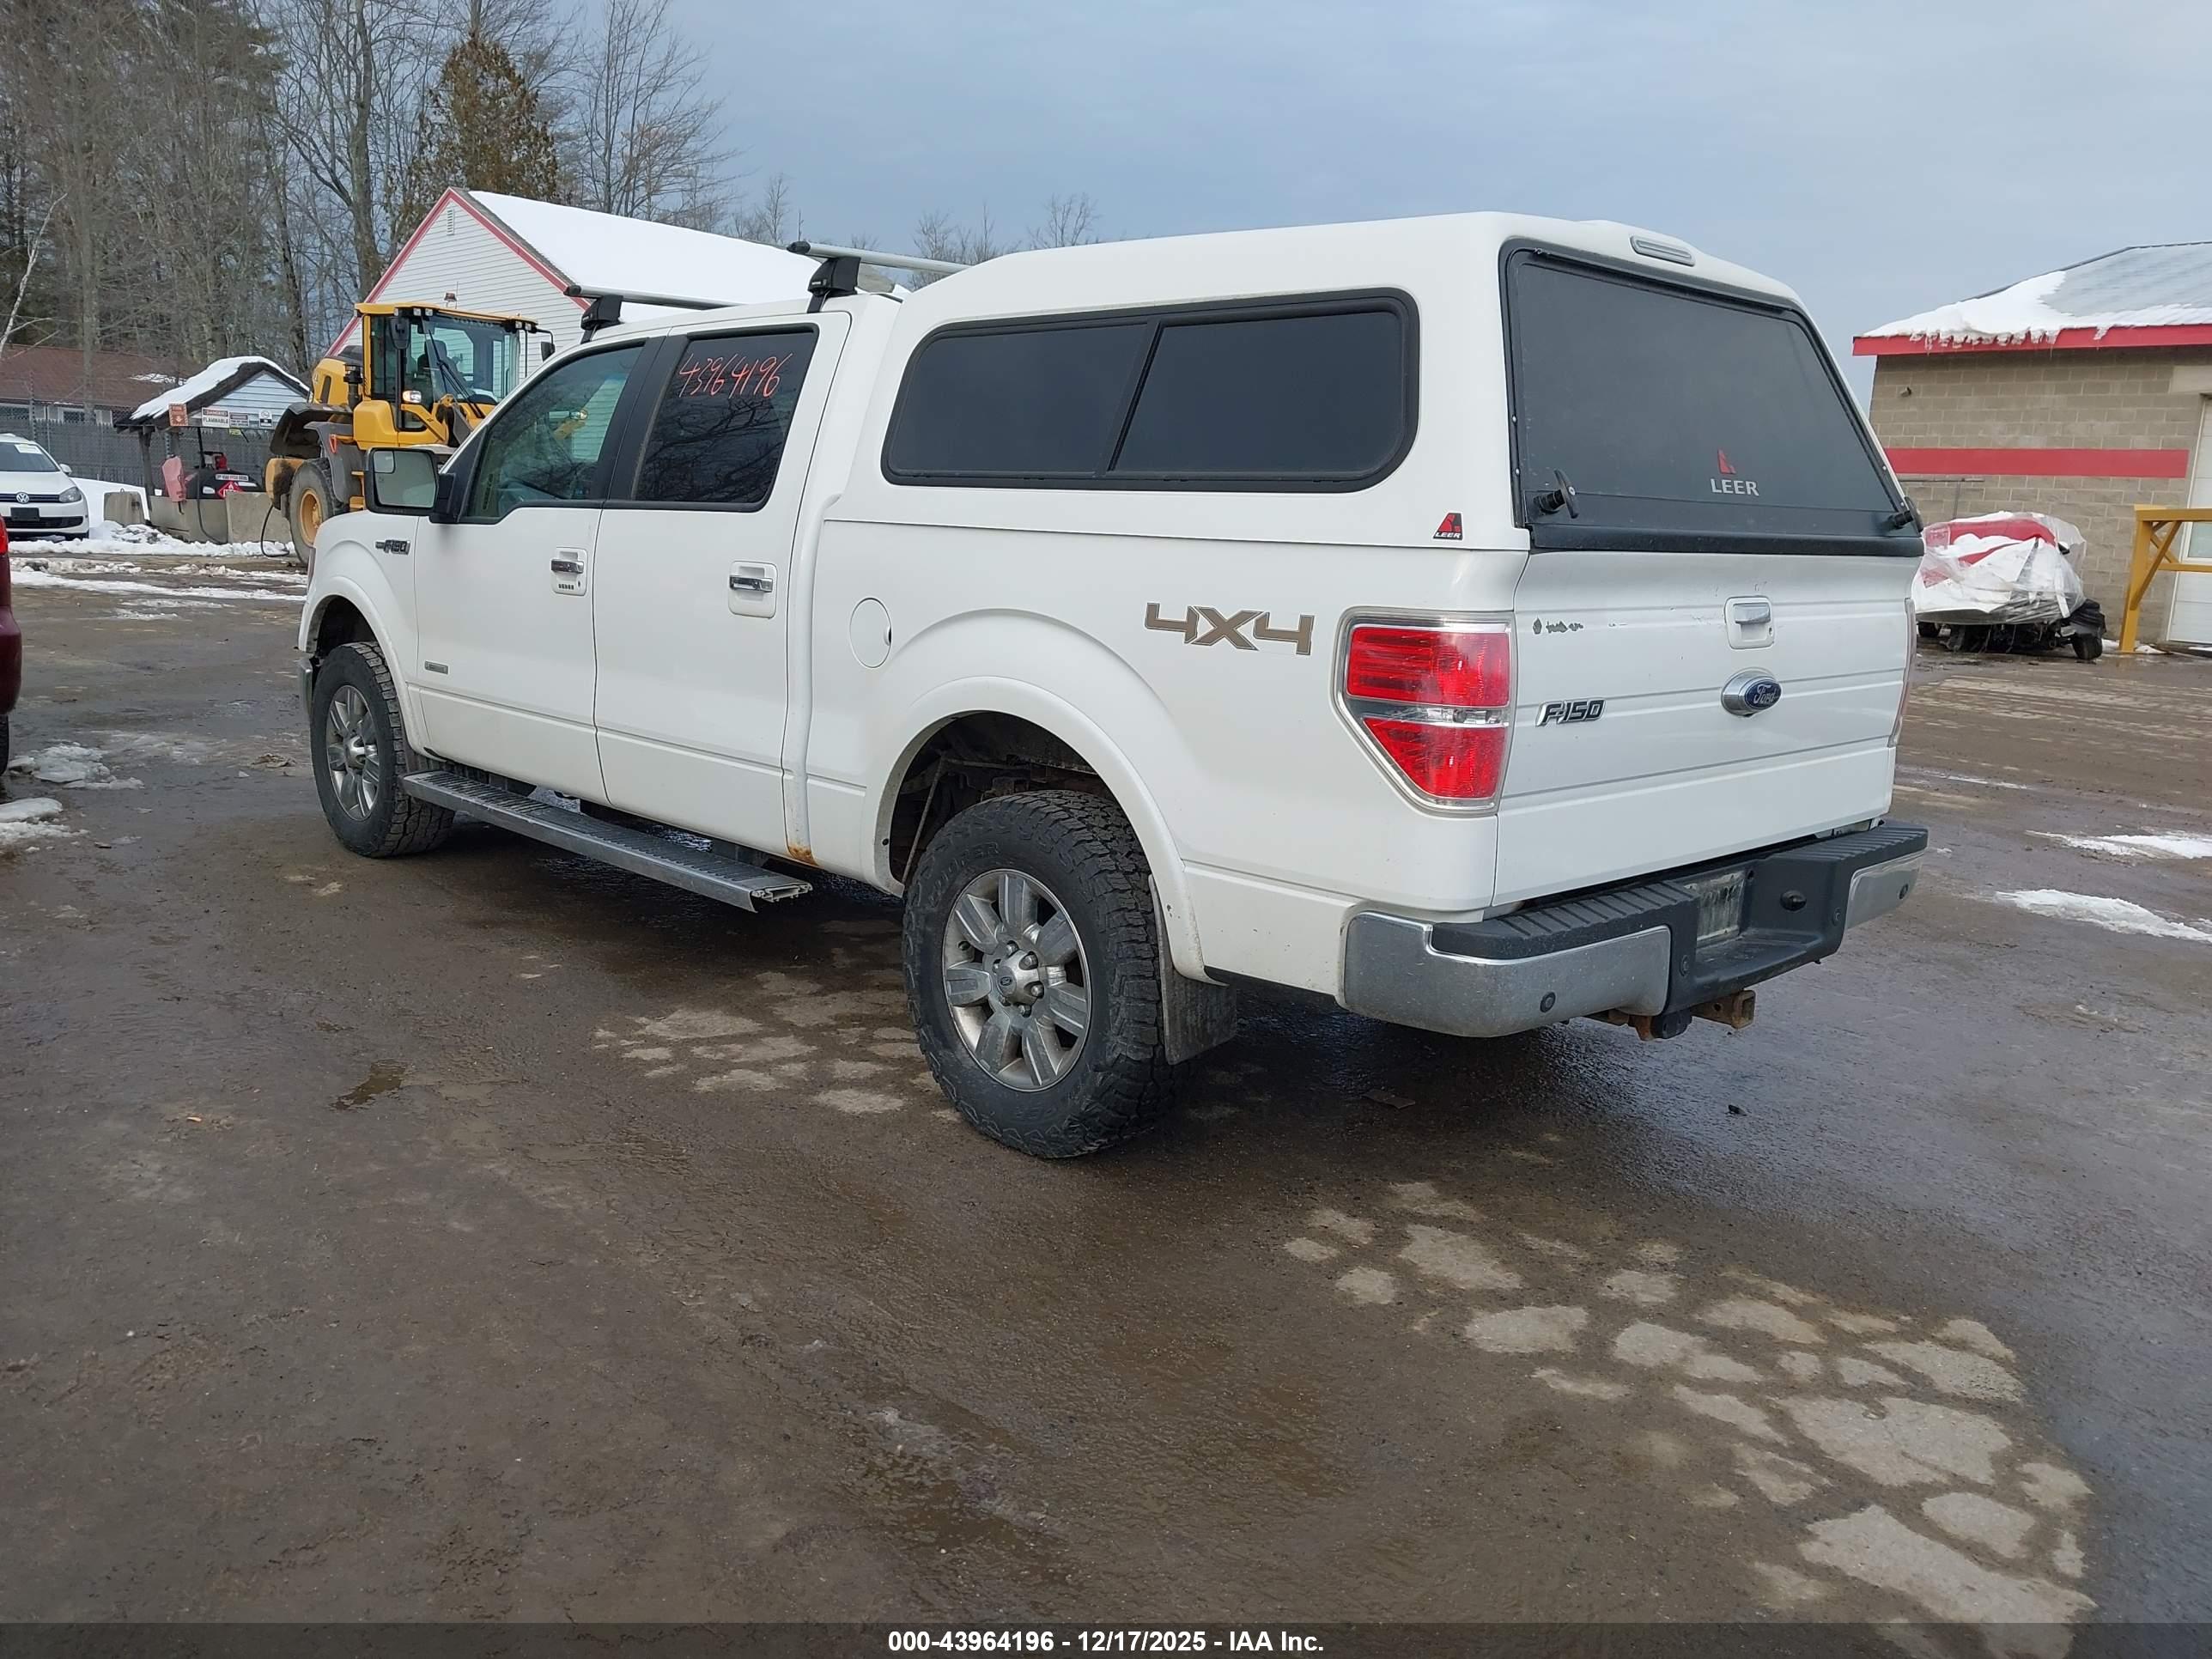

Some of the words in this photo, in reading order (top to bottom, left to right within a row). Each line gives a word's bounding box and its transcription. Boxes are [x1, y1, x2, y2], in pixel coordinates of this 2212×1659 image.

[679, 353, 793, 399] 43964196
[1711, 478, 1759, 496] LEER
[1753, 684, 1777, 704] Ford
